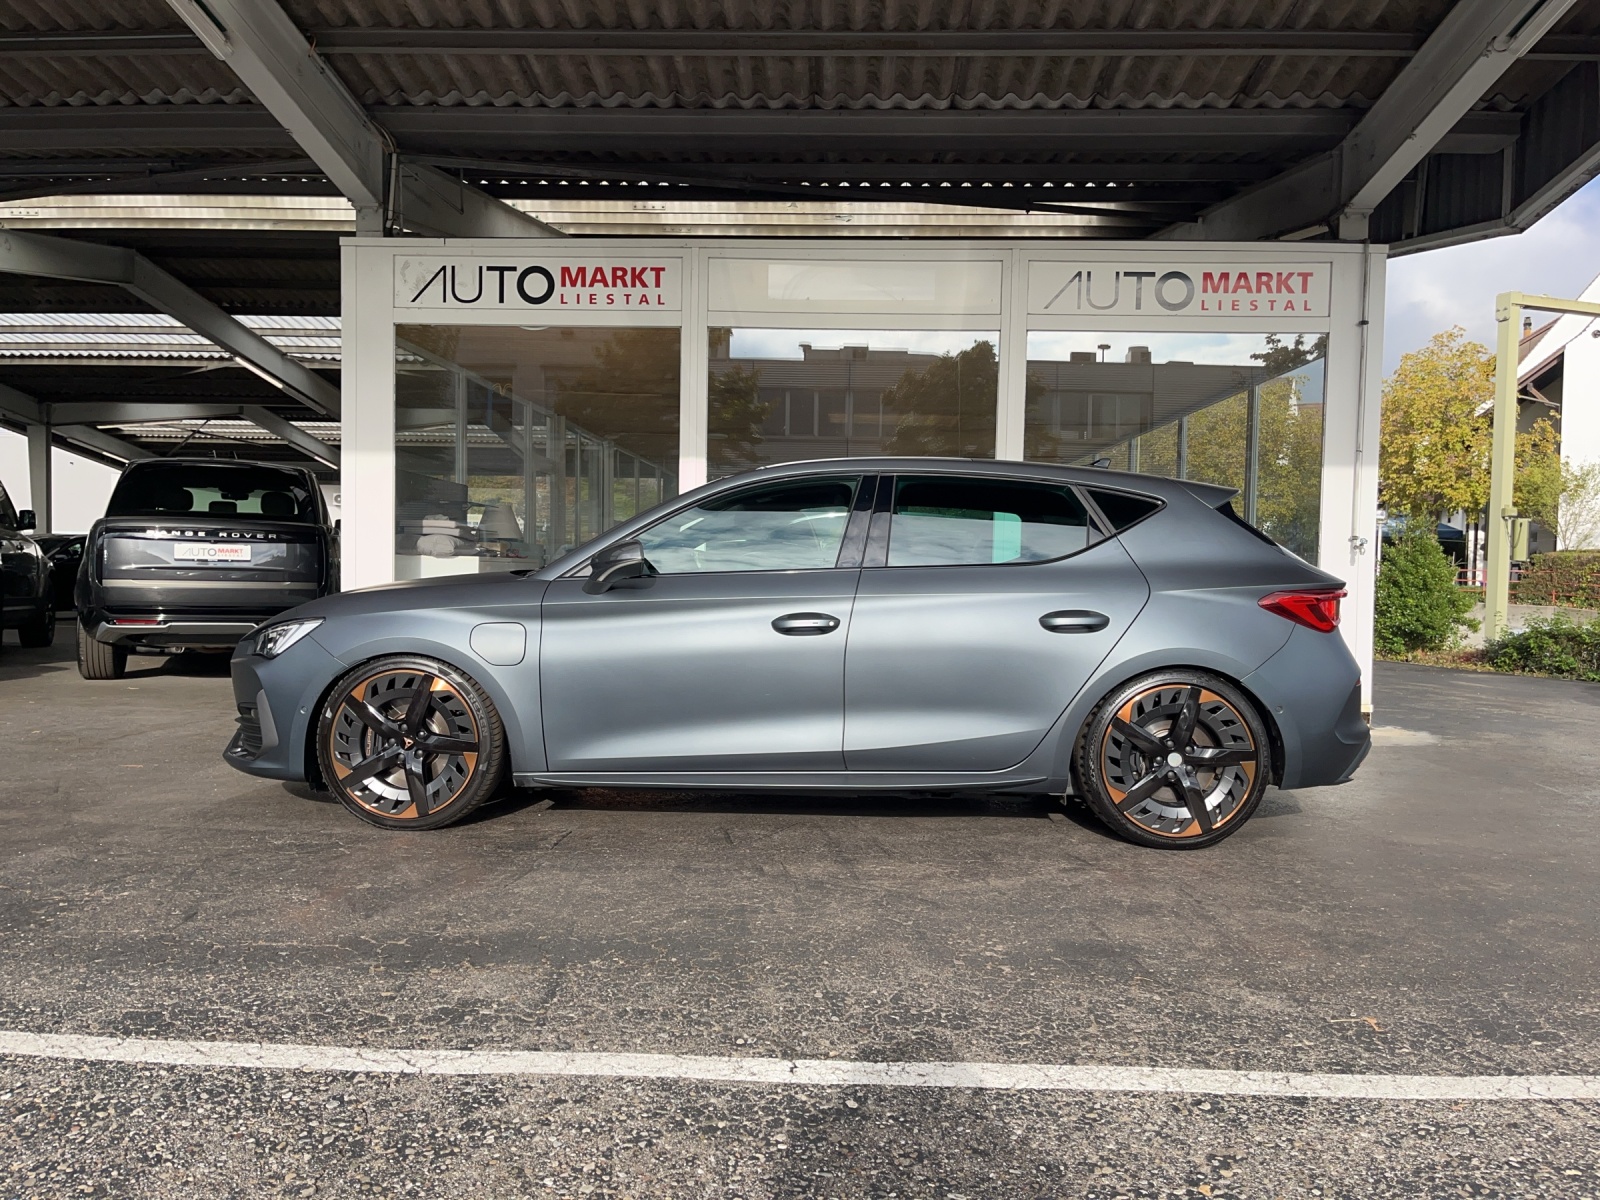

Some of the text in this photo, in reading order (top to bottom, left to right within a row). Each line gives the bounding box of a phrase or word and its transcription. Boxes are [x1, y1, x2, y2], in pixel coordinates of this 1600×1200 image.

[410, 265, 666, 305] AUTO MARKT
[1043, 270, 1314, 312] AUTO MARKT
[560, 293, 666, 306] LIESTAL
[1201, 298, 1312, 312] LIESTAL
[218, 532, 277, 540] ROVER
[182, 547, 217, 557] AUTO
[468, 693, 489, 737] NEXEN
